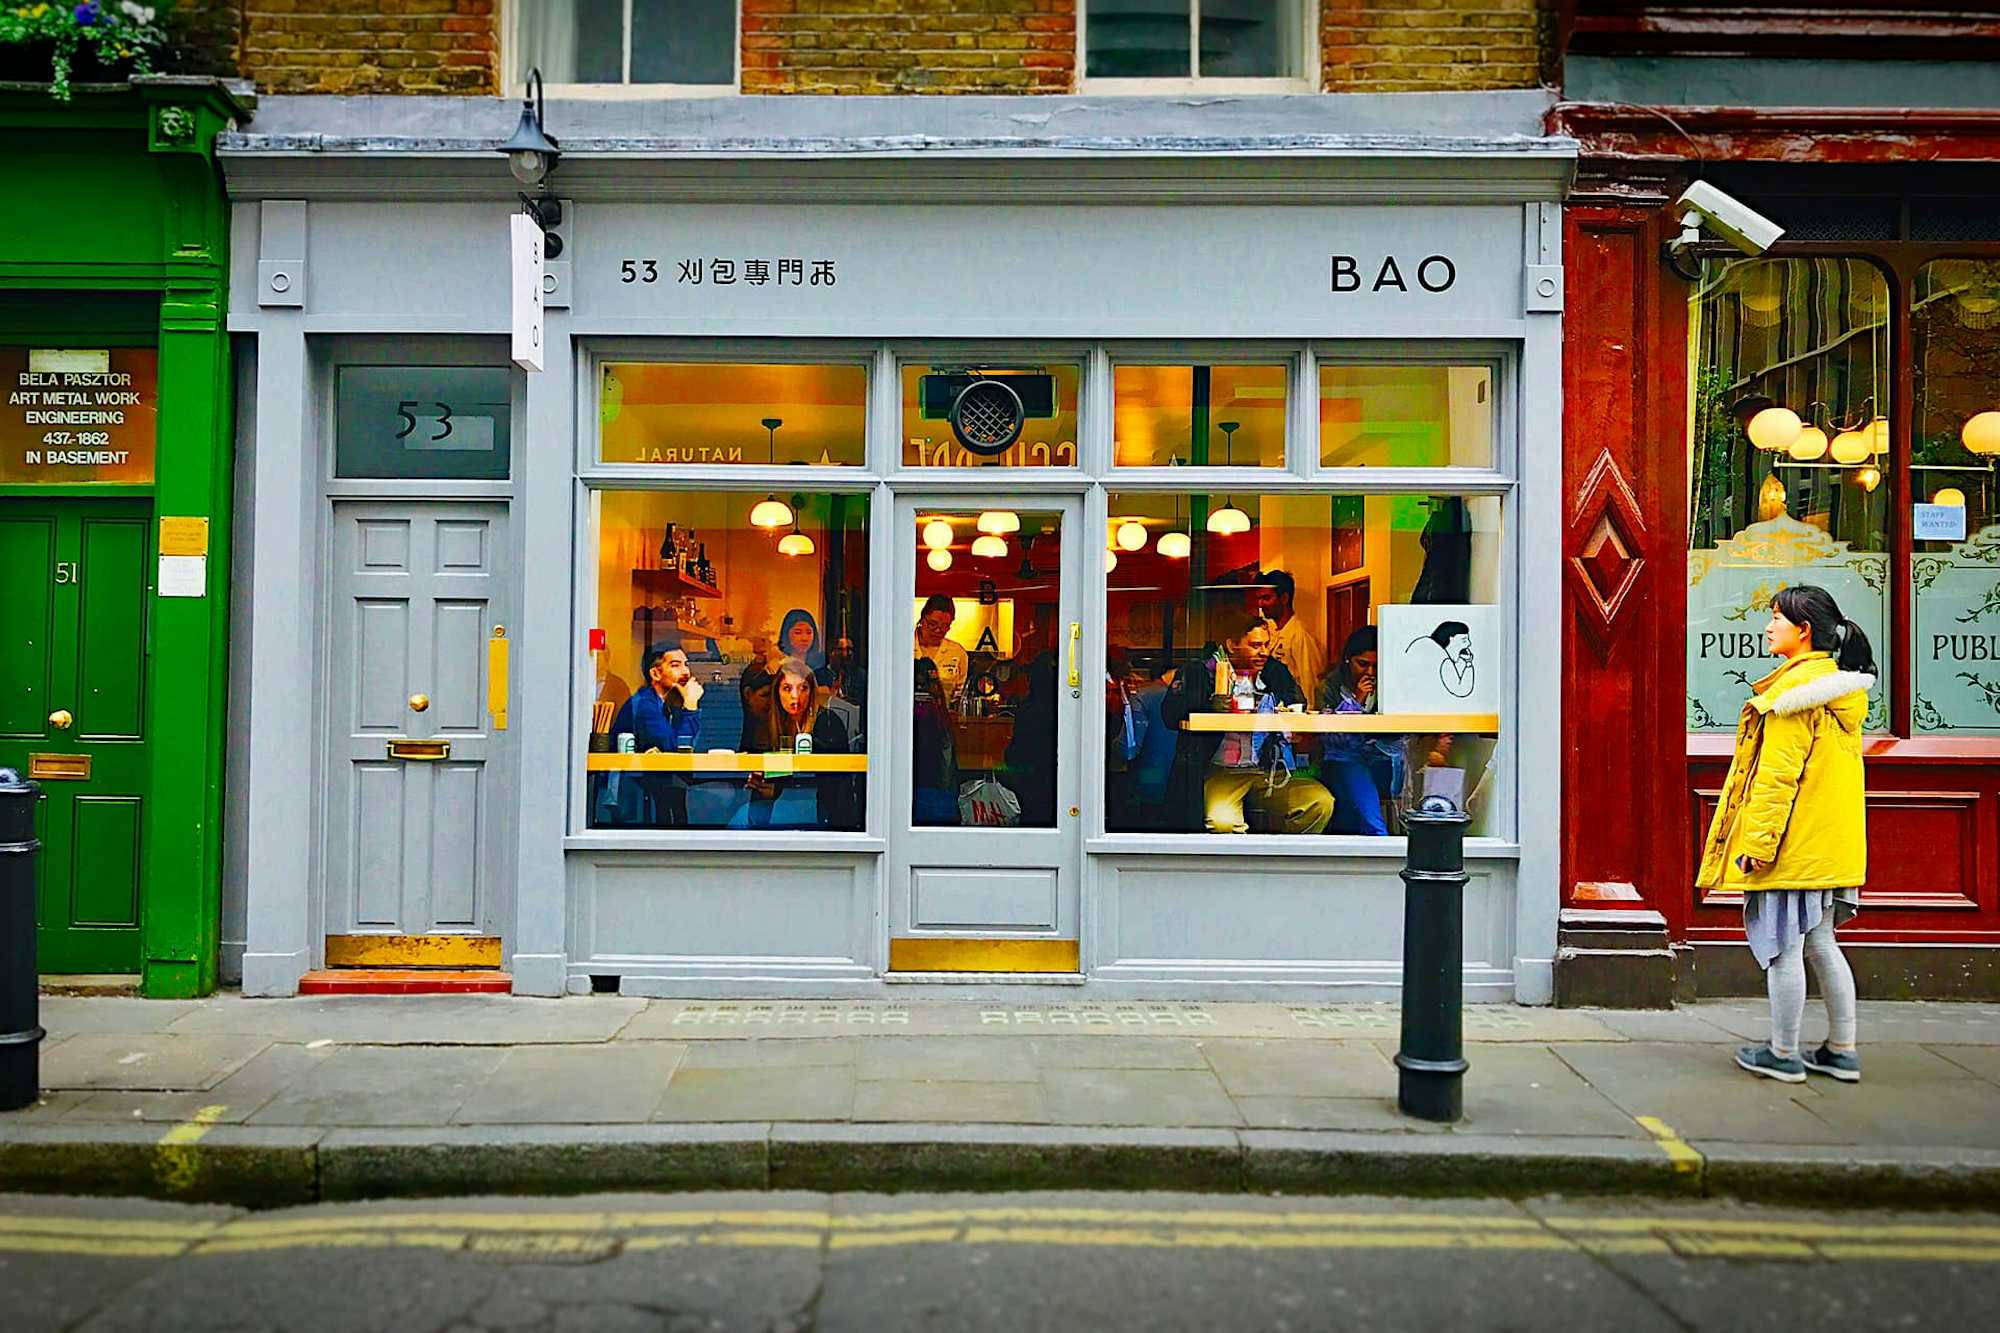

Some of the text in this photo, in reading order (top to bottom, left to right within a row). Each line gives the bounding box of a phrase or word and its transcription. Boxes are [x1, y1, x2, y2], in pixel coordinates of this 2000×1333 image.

[620, 259, 659, 283] 53
[1331, 255, 1457, 293] BAO
[19, 373, 132, 386] BELA PASZTOR
[9, 392, 141, 405] ART METAL WORK
[25, 411, 125, 424] ENGINEERING
[395, 401, 454, 441] 53
[25, 451, 129, 464] IN BASEMENT
[55, 562, 78, 585] 51
[1700, 633, 1779, 659] PUBL
